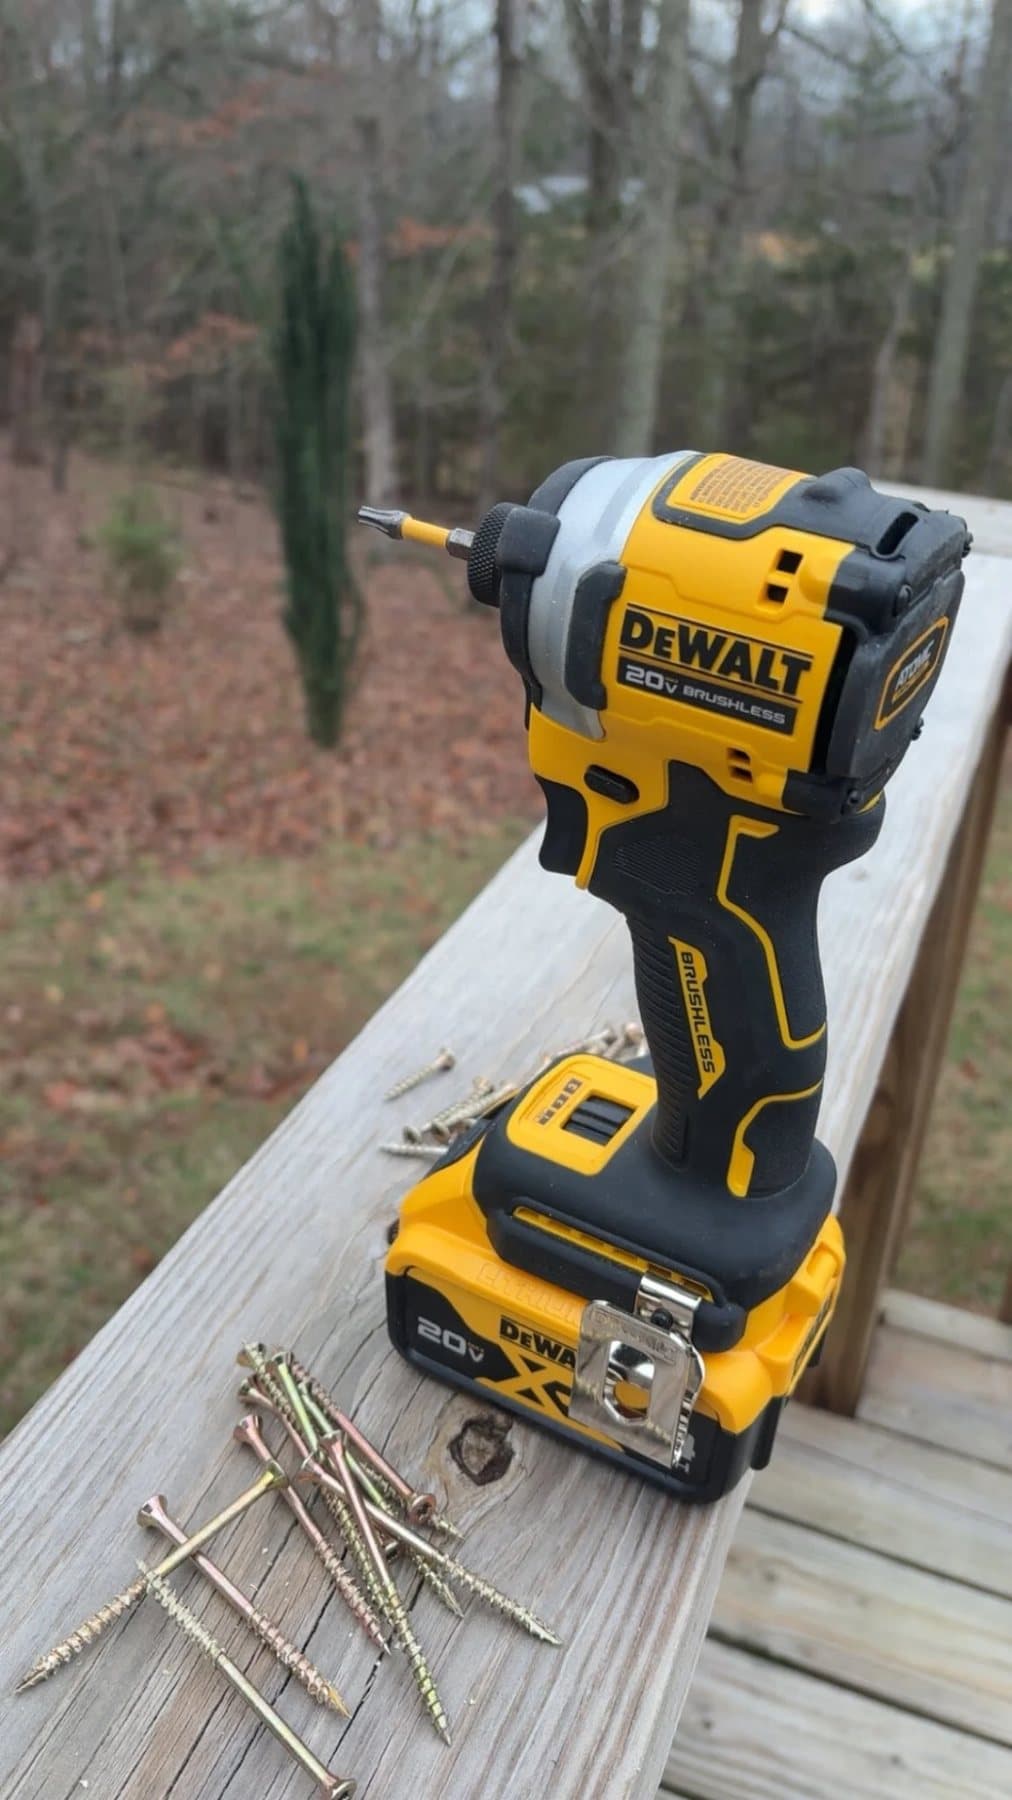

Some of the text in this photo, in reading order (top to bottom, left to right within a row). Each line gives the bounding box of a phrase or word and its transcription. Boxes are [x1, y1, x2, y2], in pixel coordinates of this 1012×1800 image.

[683, 685, 786, 725] BRUSHLESS
[681, 951, 716, 1074] BRUSHLESS
[500, 1317, 577, 1369] DEWA
